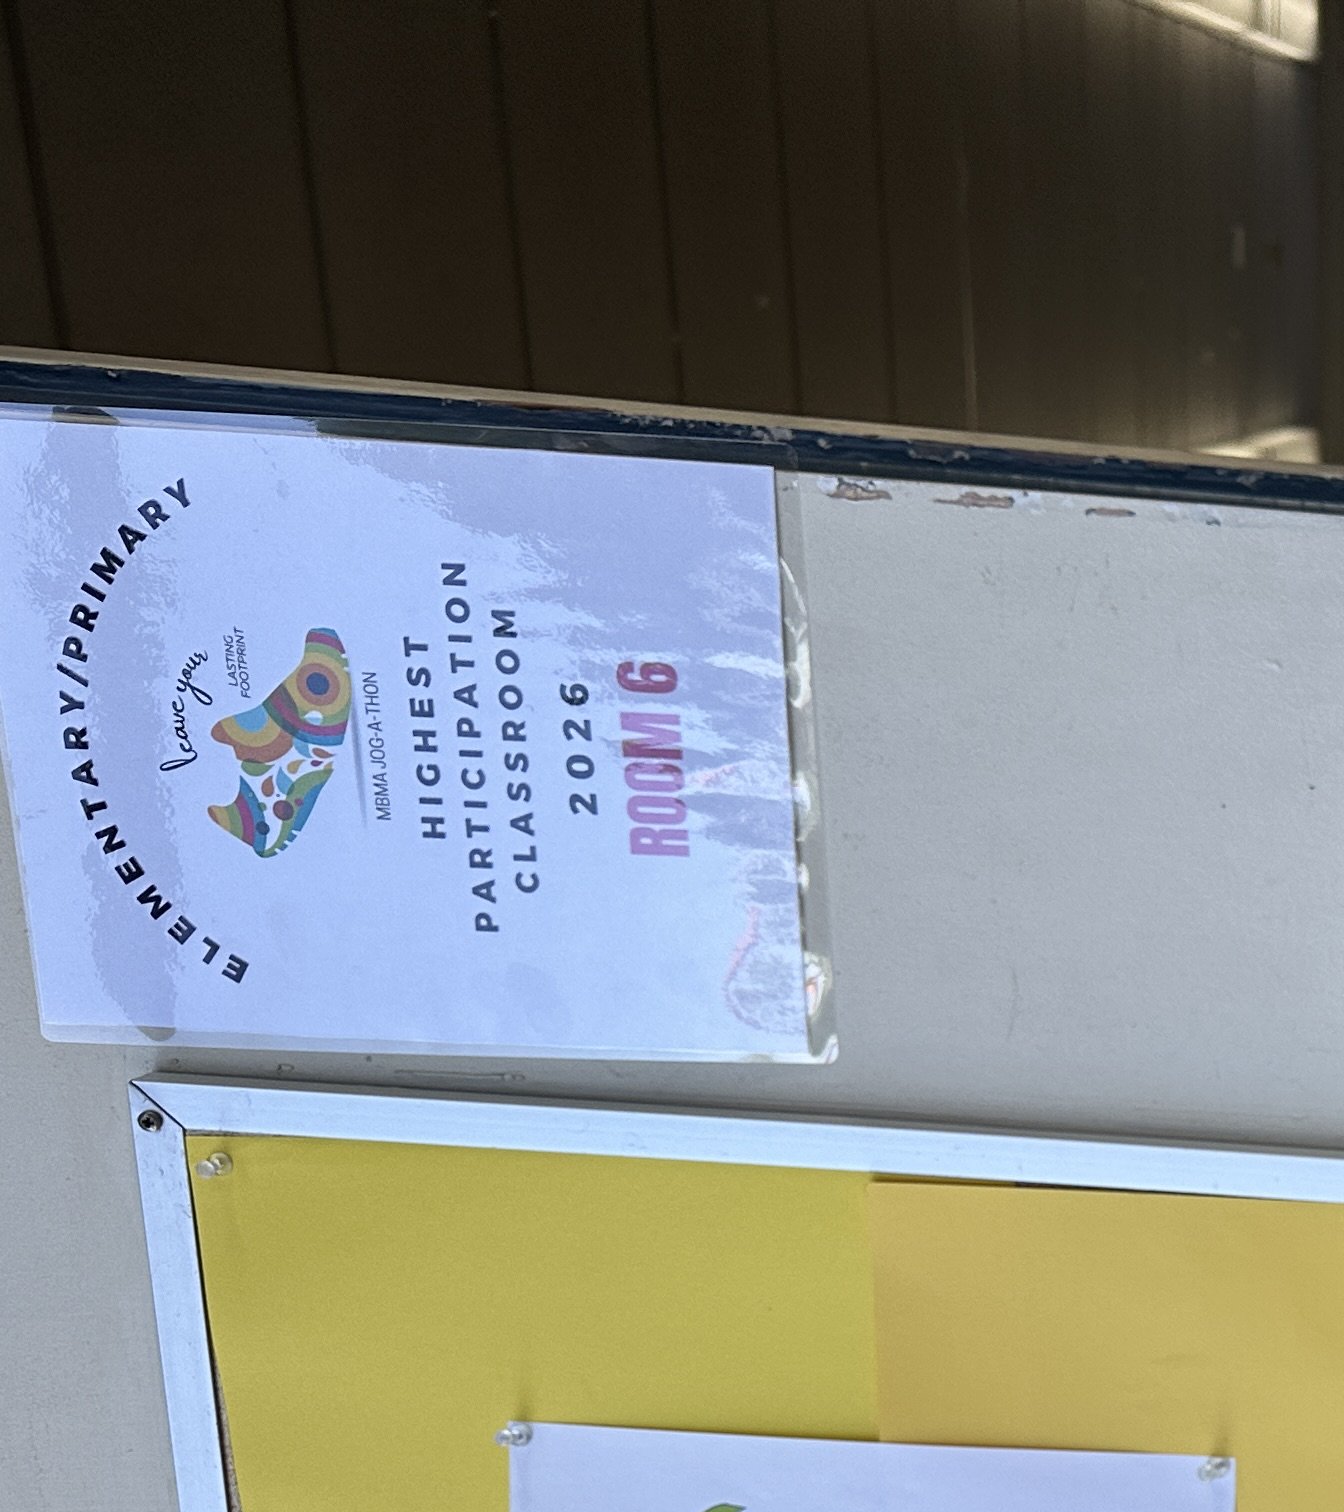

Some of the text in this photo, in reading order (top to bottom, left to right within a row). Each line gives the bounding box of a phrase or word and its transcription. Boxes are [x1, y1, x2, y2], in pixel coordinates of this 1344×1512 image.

[57, 477, 251, 984] ELEMENTARY/PRIMARY
[160, 650, 213, 771] leave your
[222, 634, 238, 686] LASTING
[233, 626, 251, 699] FOOTPRINT
[361, 671, 391, 821] MBMA JOG-A-THON
[402, 636, 447, 841] HIGHEST
[441, 562, 500, 934] PARTICIPATION
[491, 608, 540, 894] CLASSROOM
[560, 682, 598, 816] 2026
[617, 660, 690, 858] ROOM 6
